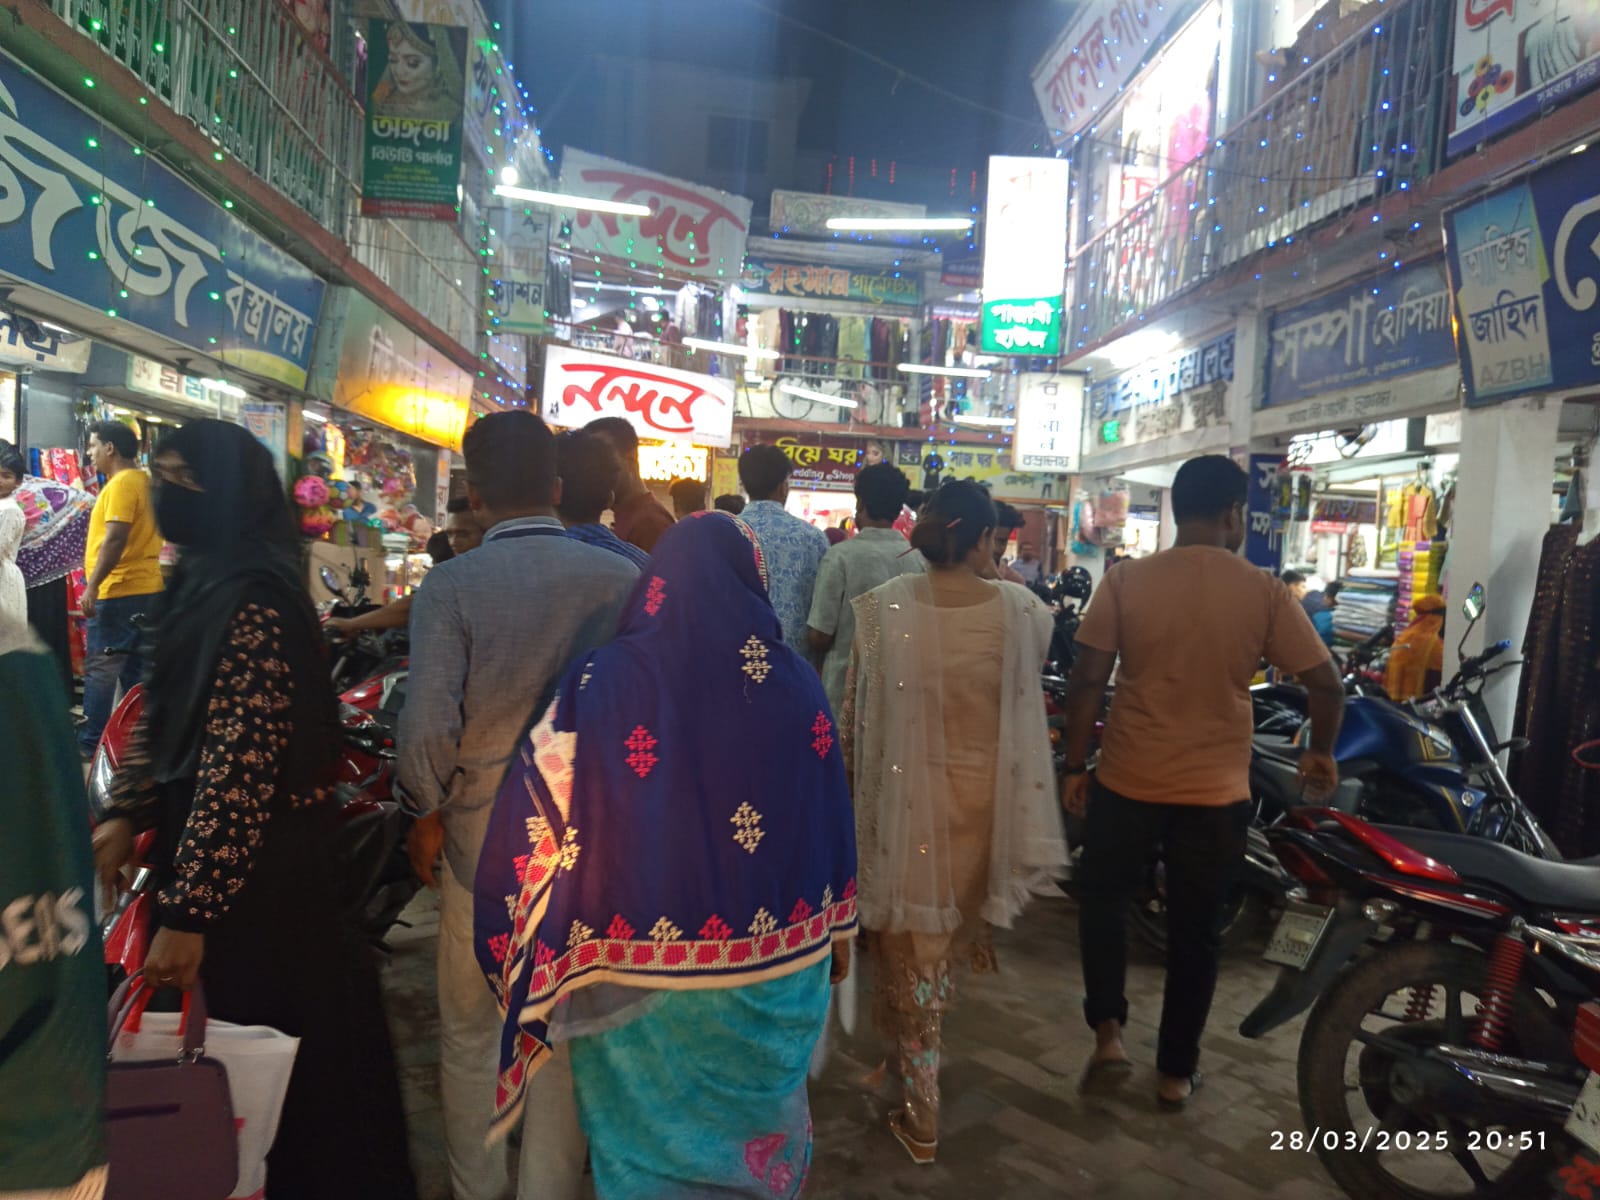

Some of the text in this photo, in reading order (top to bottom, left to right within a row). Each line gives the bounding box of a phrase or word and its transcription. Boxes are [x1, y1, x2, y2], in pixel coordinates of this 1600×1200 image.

[372, 115, 451, 147] অঙ্গনা
[1464, 223, 1532, 277] আজিজ
[764, 262, 850, 297] রহমান
[225, 269, 313, 360] বস্ত্রালয়
[1272, 292, 1375, 380] সম্পা
[1468, 289, 1540, 345] জাহিদ
[1478, 352, 1546, 387] AZBH
[560, 363, 726, 433] নন্দন
[776, 437, 857, 466] বিয়ে ঘর
[792, 469, 824, 481] edding
